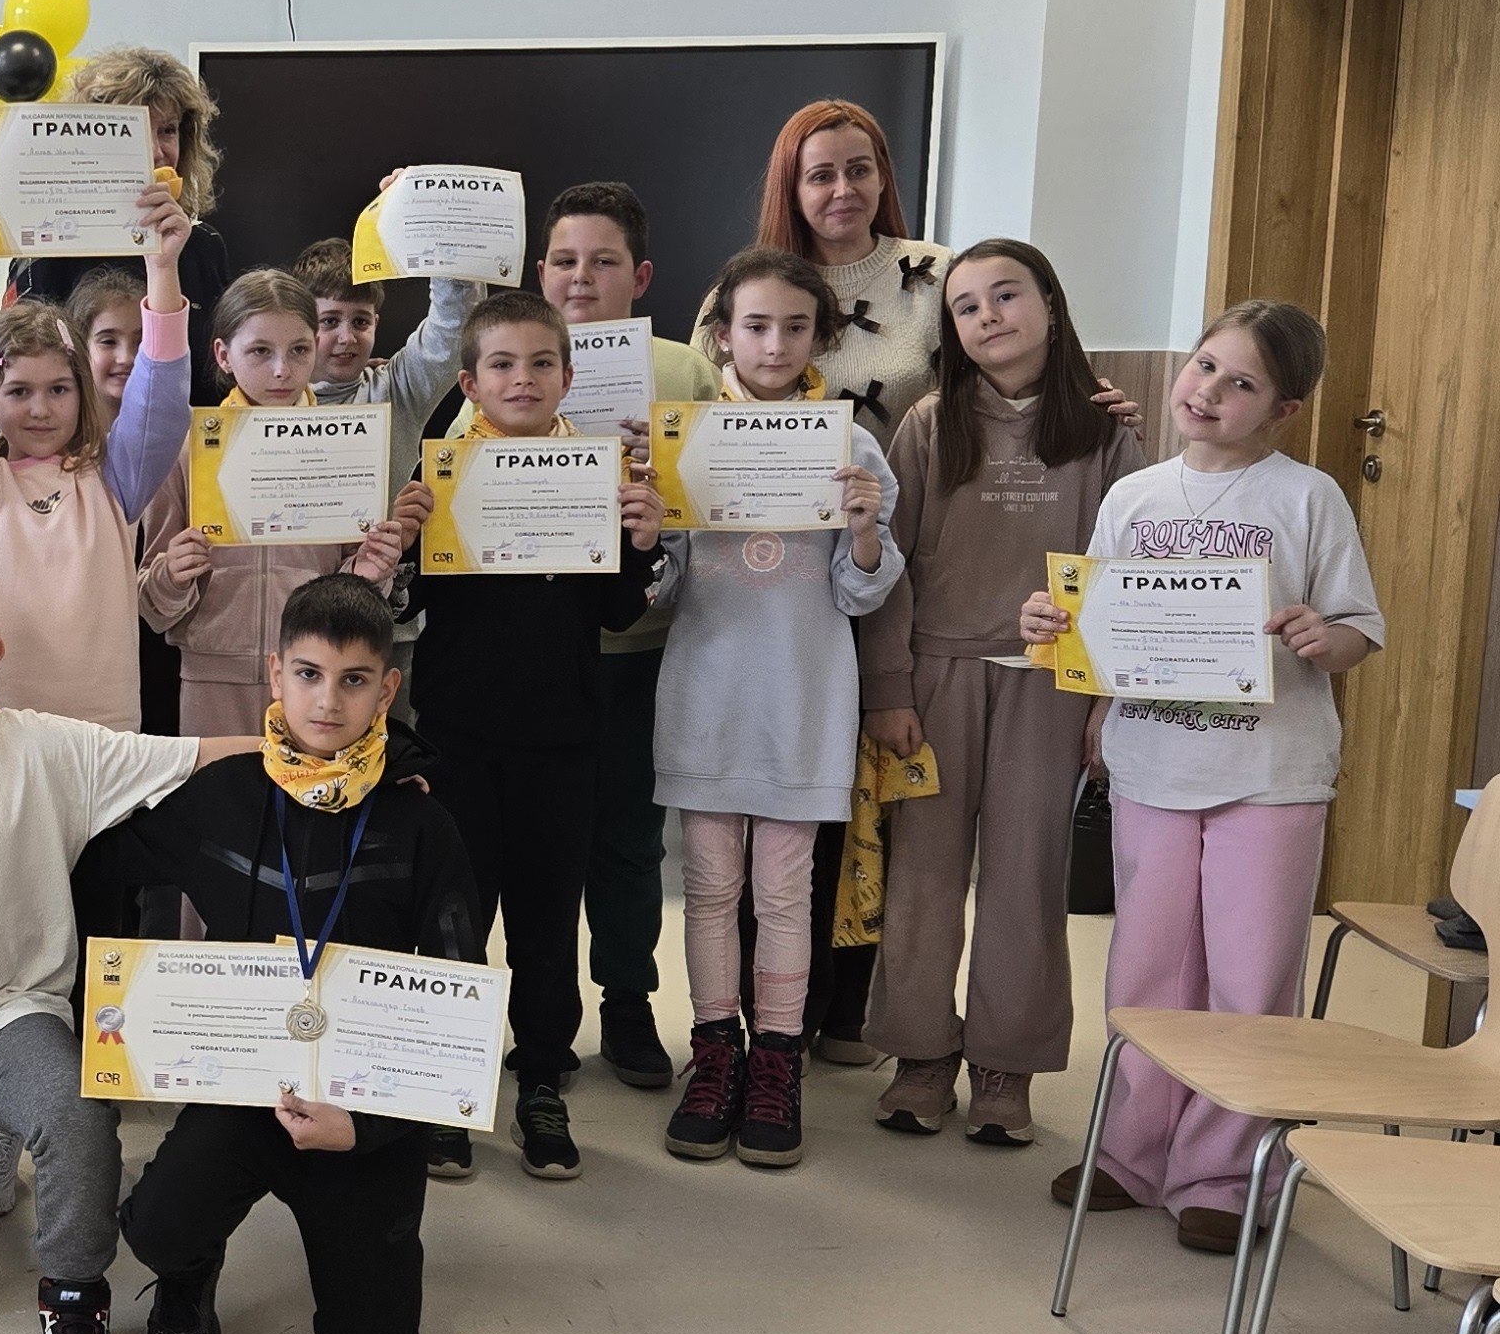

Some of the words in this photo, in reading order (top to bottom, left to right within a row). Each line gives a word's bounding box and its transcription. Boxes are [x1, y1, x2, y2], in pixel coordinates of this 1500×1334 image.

[32, 123, 132, 137] ГРАМОТА
[414, 179, 505, 192] ГРАМОТА
[575, 336, 630, 350] МОТА
[264, 422, 367, 437] ГРАМОТА
[724, 418, 828, 430] ГРАМОТА
[496, 454, 598, 467] ГРАМОТА
[995, 472, 1009, 484] all
[1001, 492, 1024, 501] STREET
[1026, 492, 1059, 501] COUTURE
[1131, 519, 1274, 559] ROLLING
[1123, 578, 1242, 590] ГРАМОТА
[1153, 707, 1207, 731] YORK
[1209, 713, 1260, 730] CITY
[157, 962, 226, 975] SCHOOL
[232, 964, 300, 978] WINNER
[349, 958, 385, 969] BULGARIAN
[387, 964, 418, 974] NATIONAL
[420, 968, 447, 978] ENGLISH
[449, 972, 479, 983] SPELLING
[359, 970, 480, 1001] ГРАМОТА
[191, 1045, 258, 1054] CONGRATULATIONS!
[371, 1064, 443, 1079] CONGRATULATIONS!
